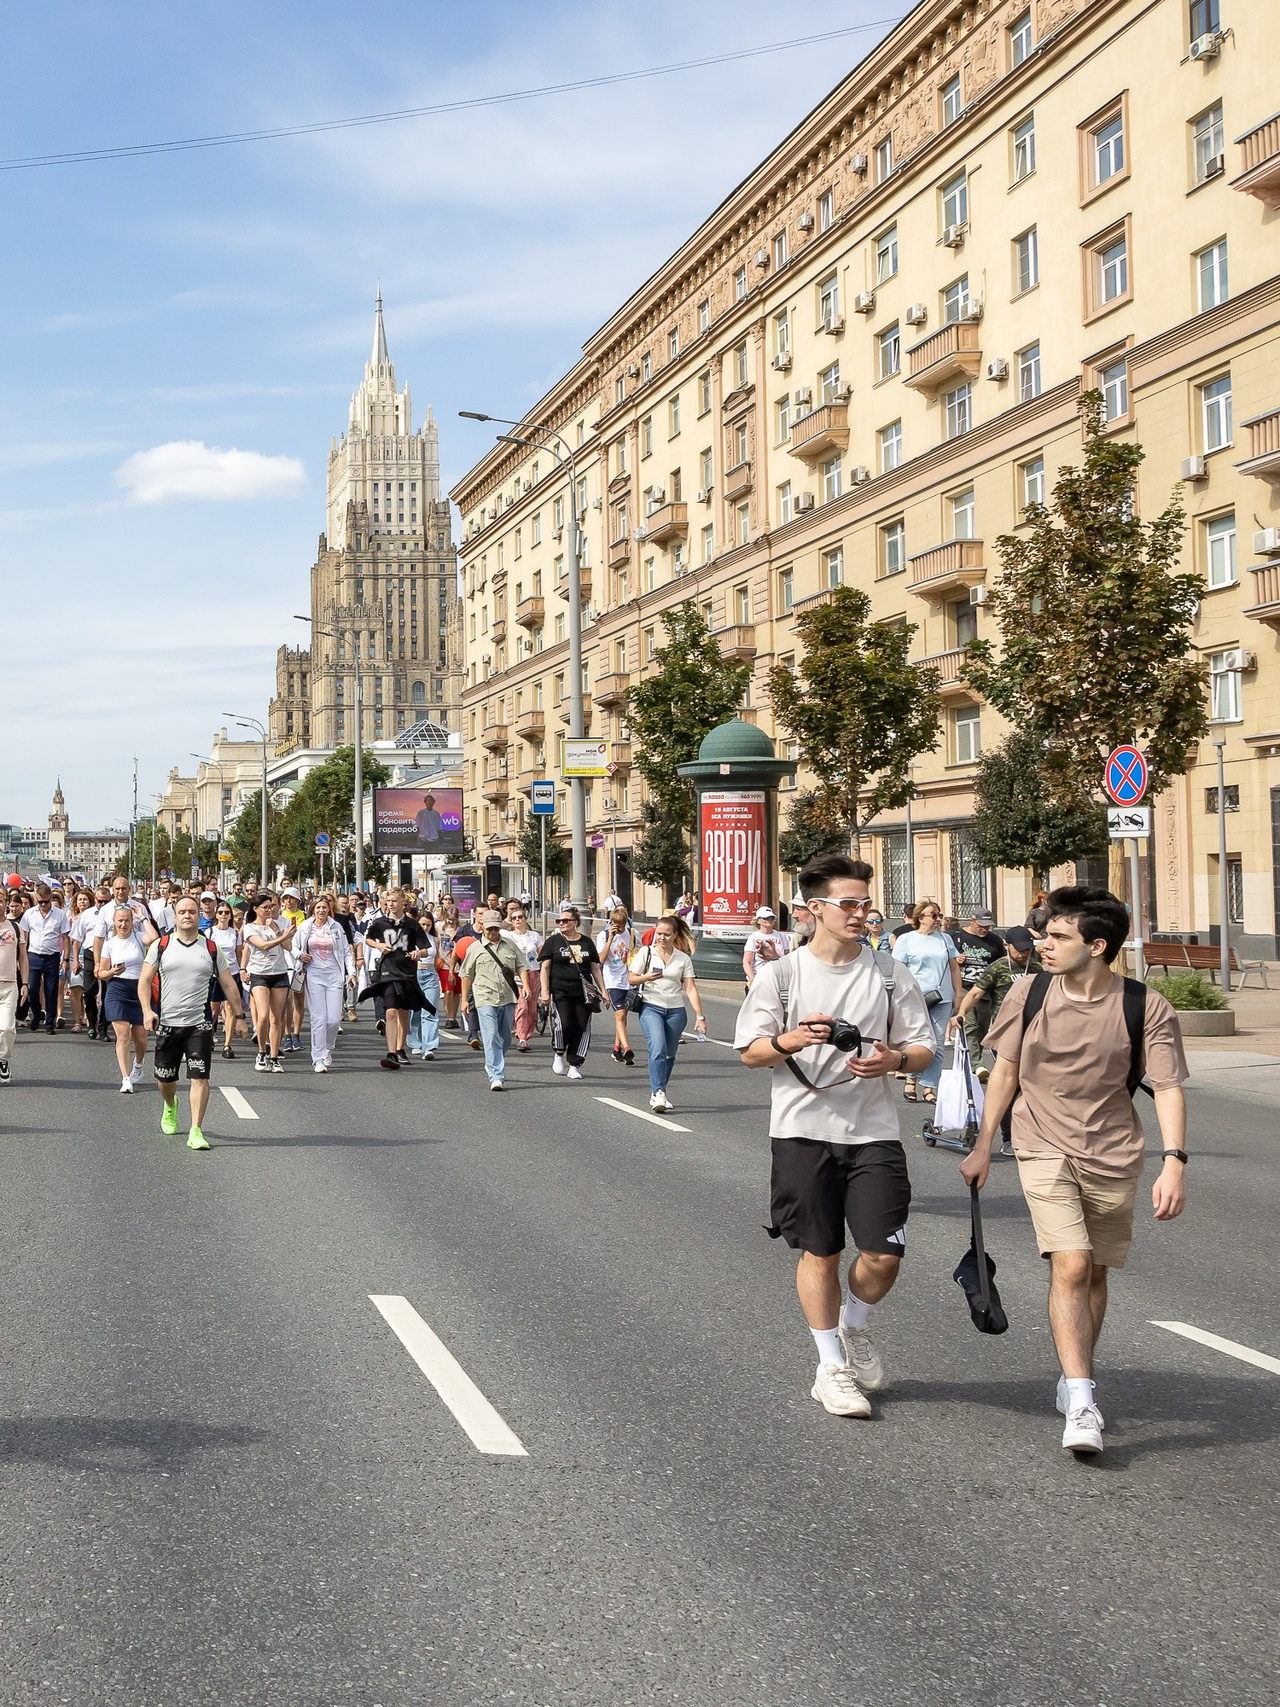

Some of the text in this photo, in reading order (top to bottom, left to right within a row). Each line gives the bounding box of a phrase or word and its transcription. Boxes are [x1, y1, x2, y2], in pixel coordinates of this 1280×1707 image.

[378, 816, 417, 825] обновить
[442, 815, 459, 825] wb
[378, 825, 418, 834] гардероб
[705, 829, 761, 894] ЗВЕРИ
